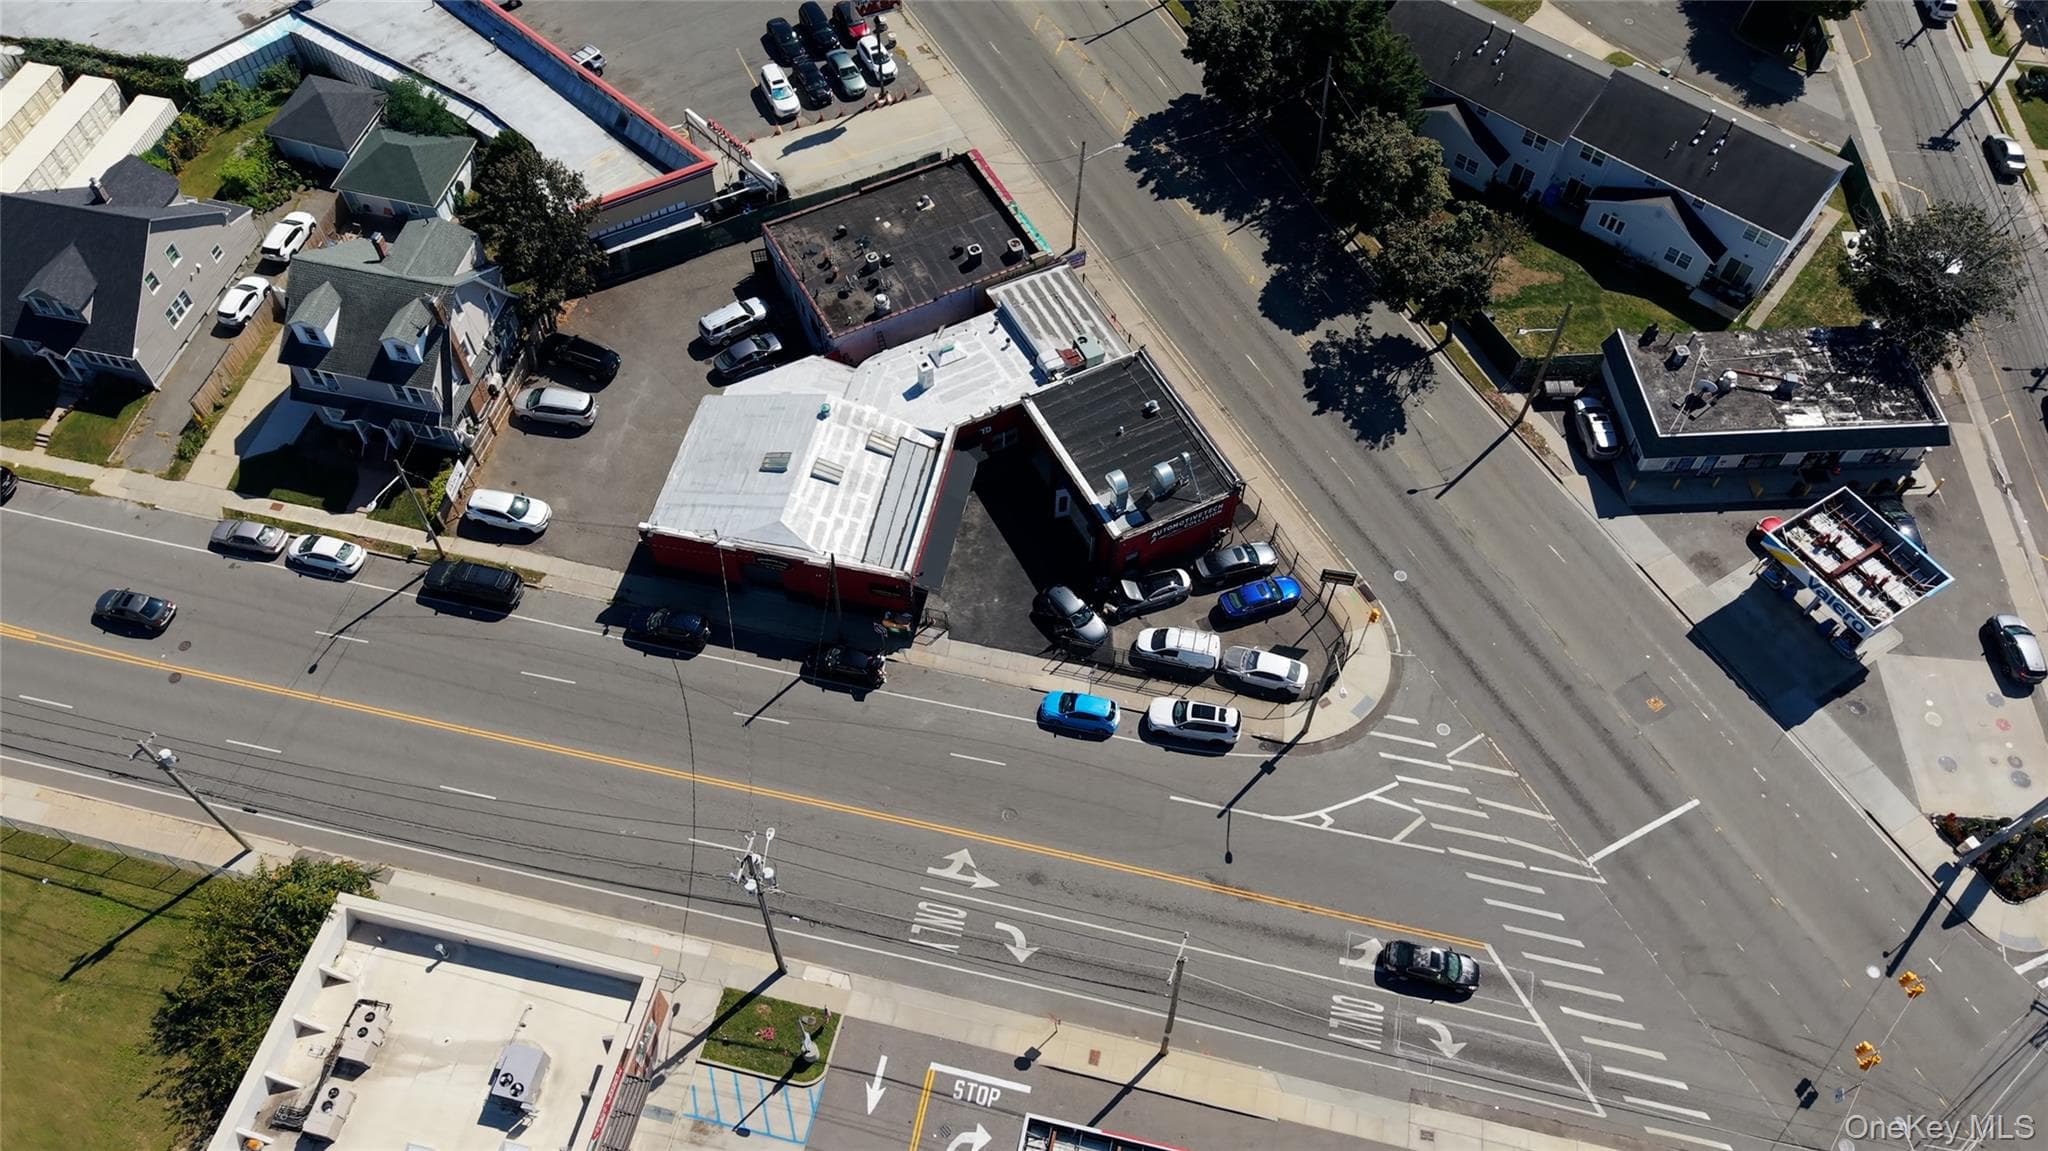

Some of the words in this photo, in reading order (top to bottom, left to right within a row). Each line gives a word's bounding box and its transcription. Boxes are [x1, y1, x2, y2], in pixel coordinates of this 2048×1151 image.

[908, 901, 968, 954] ONLY
[1328, 994, 1385, 1050] ONLY
[953, 1079, 1001, 1108] STOP
